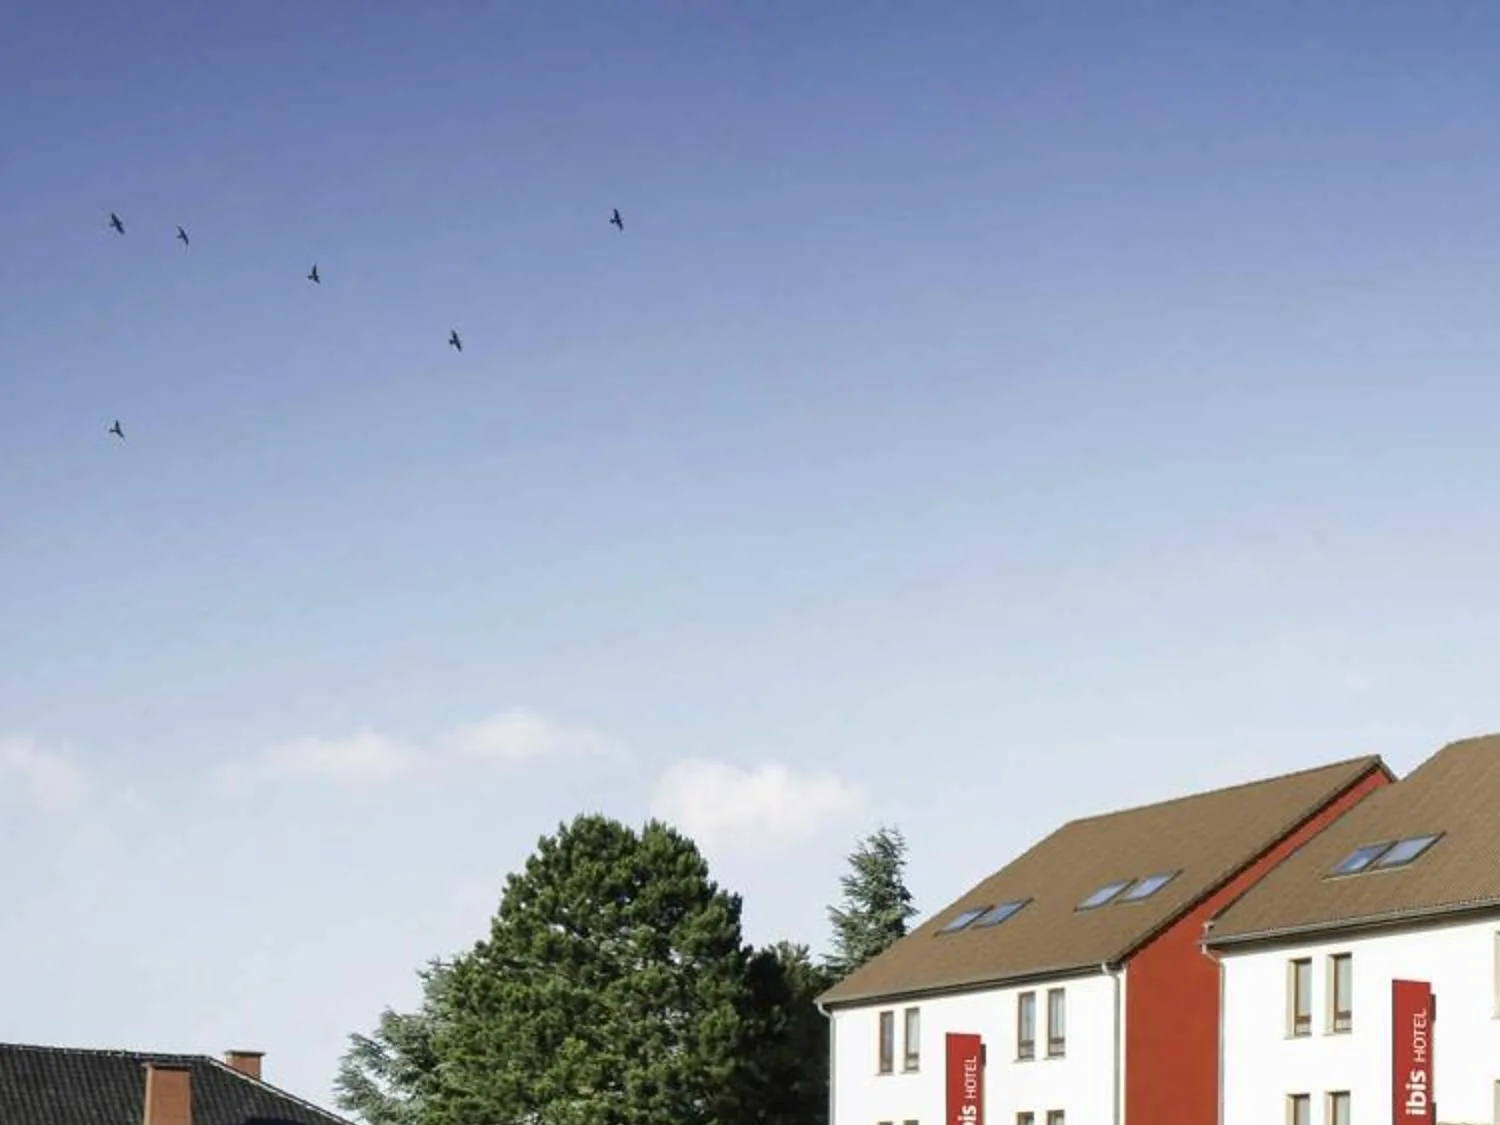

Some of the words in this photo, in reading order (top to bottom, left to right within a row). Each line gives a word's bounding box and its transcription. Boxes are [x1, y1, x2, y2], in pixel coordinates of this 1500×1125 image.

[1413, 1008, 1427, 1063] HOTEL
[963, 1055, 977, 1099] HOTEL
[1405, 1069, 1427, 1116] ibis
